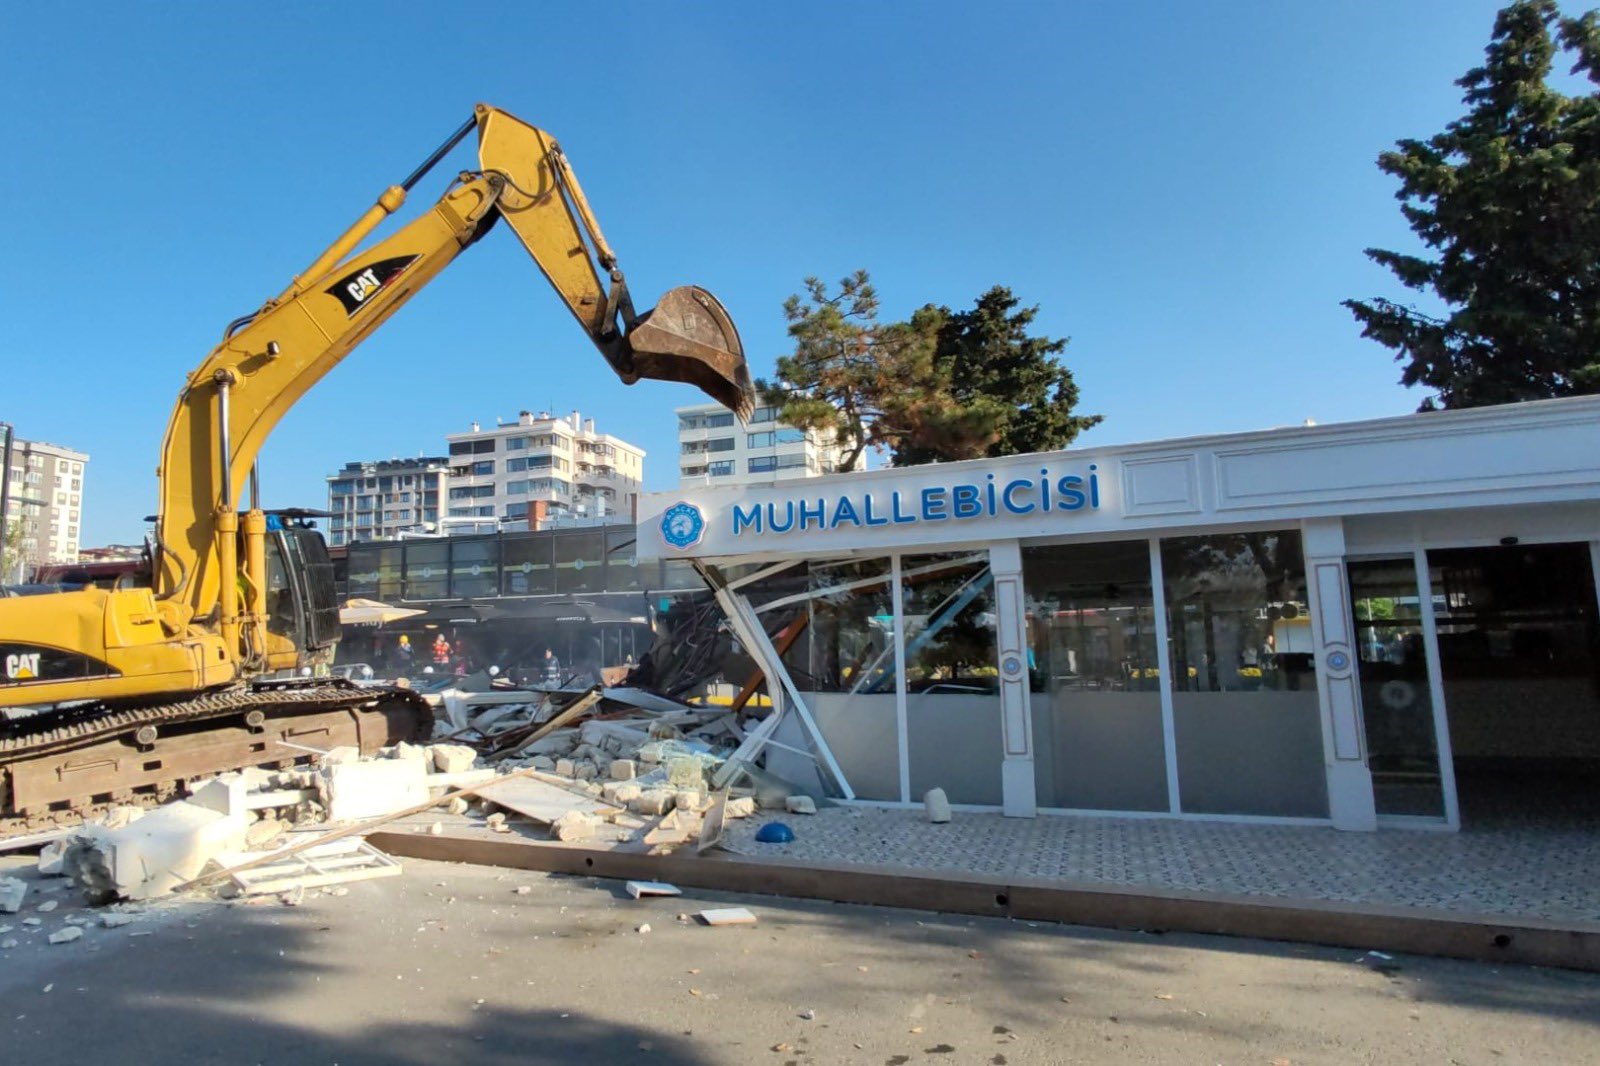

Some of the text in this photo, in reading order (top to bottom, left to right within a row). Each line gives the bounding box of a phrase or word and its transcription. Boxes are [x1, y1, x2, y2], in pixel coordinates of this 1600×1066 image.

[347, 268, 381, 302] CAT
[733, 464, 1099, 535] MUHALLEBİCİSİ
[6, 653, 40, 679] CAT
